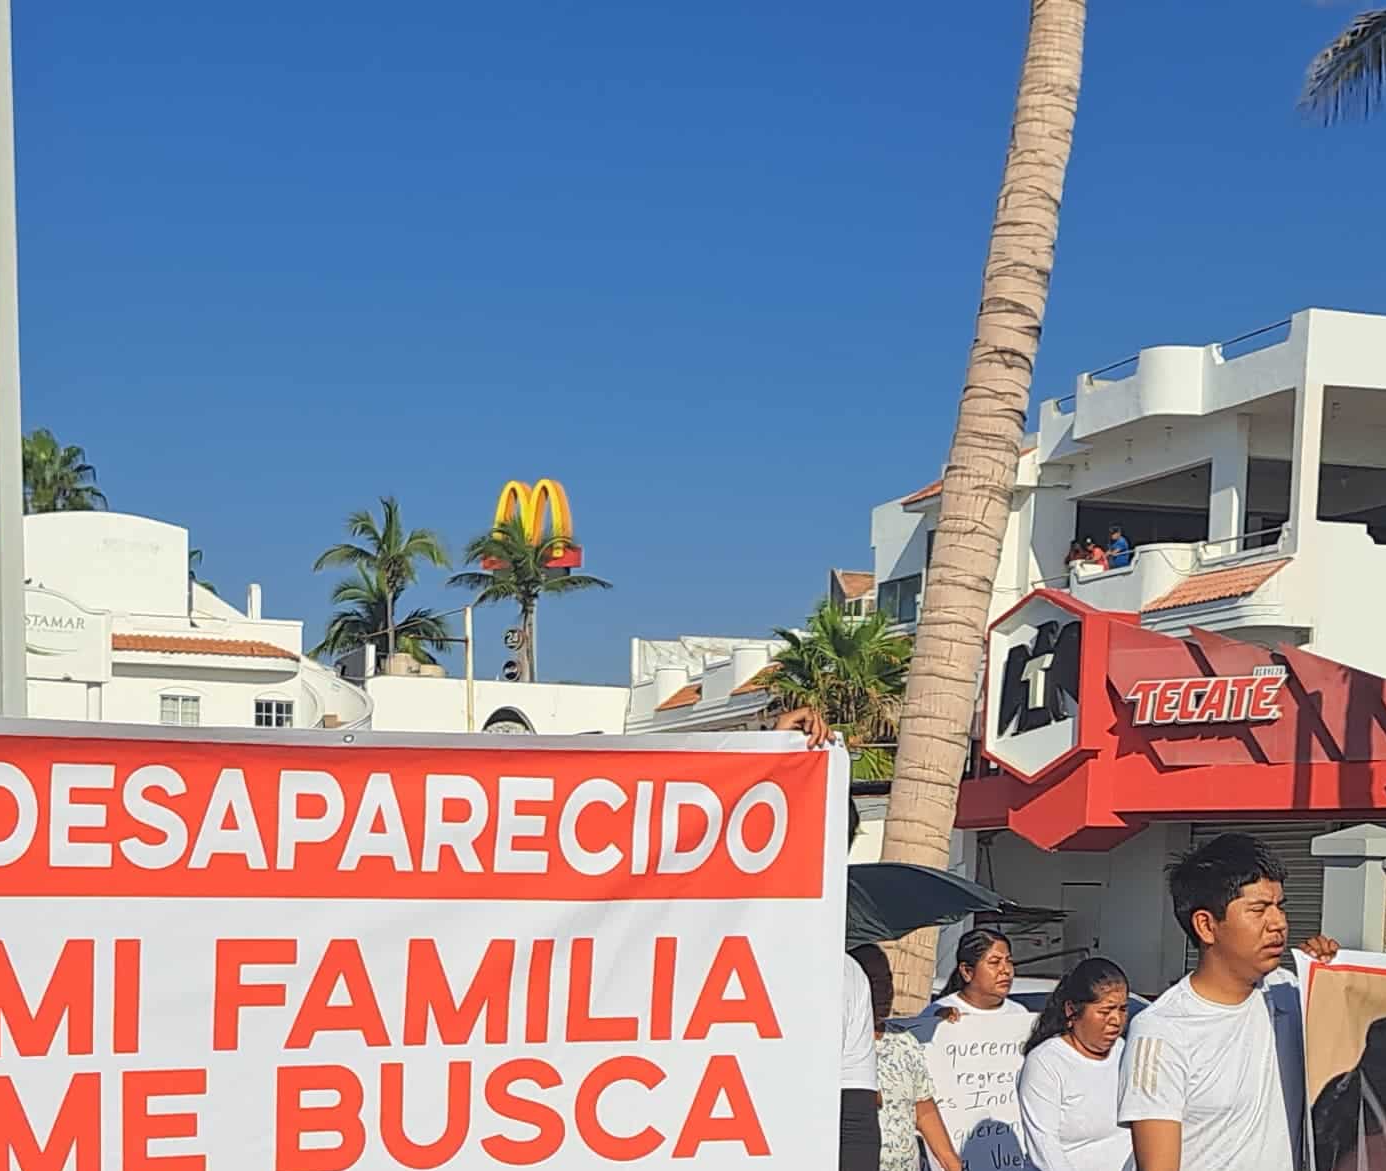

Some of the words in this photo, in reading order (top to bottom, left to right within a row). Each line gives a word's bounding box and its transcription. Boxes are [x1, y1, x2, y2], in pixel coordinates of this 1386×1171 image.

[24, 614, 85, 631] STAMAR
[1125, 673, 1289, 726] TECATE
[213, 935, 783, 1051] FAMILIA
